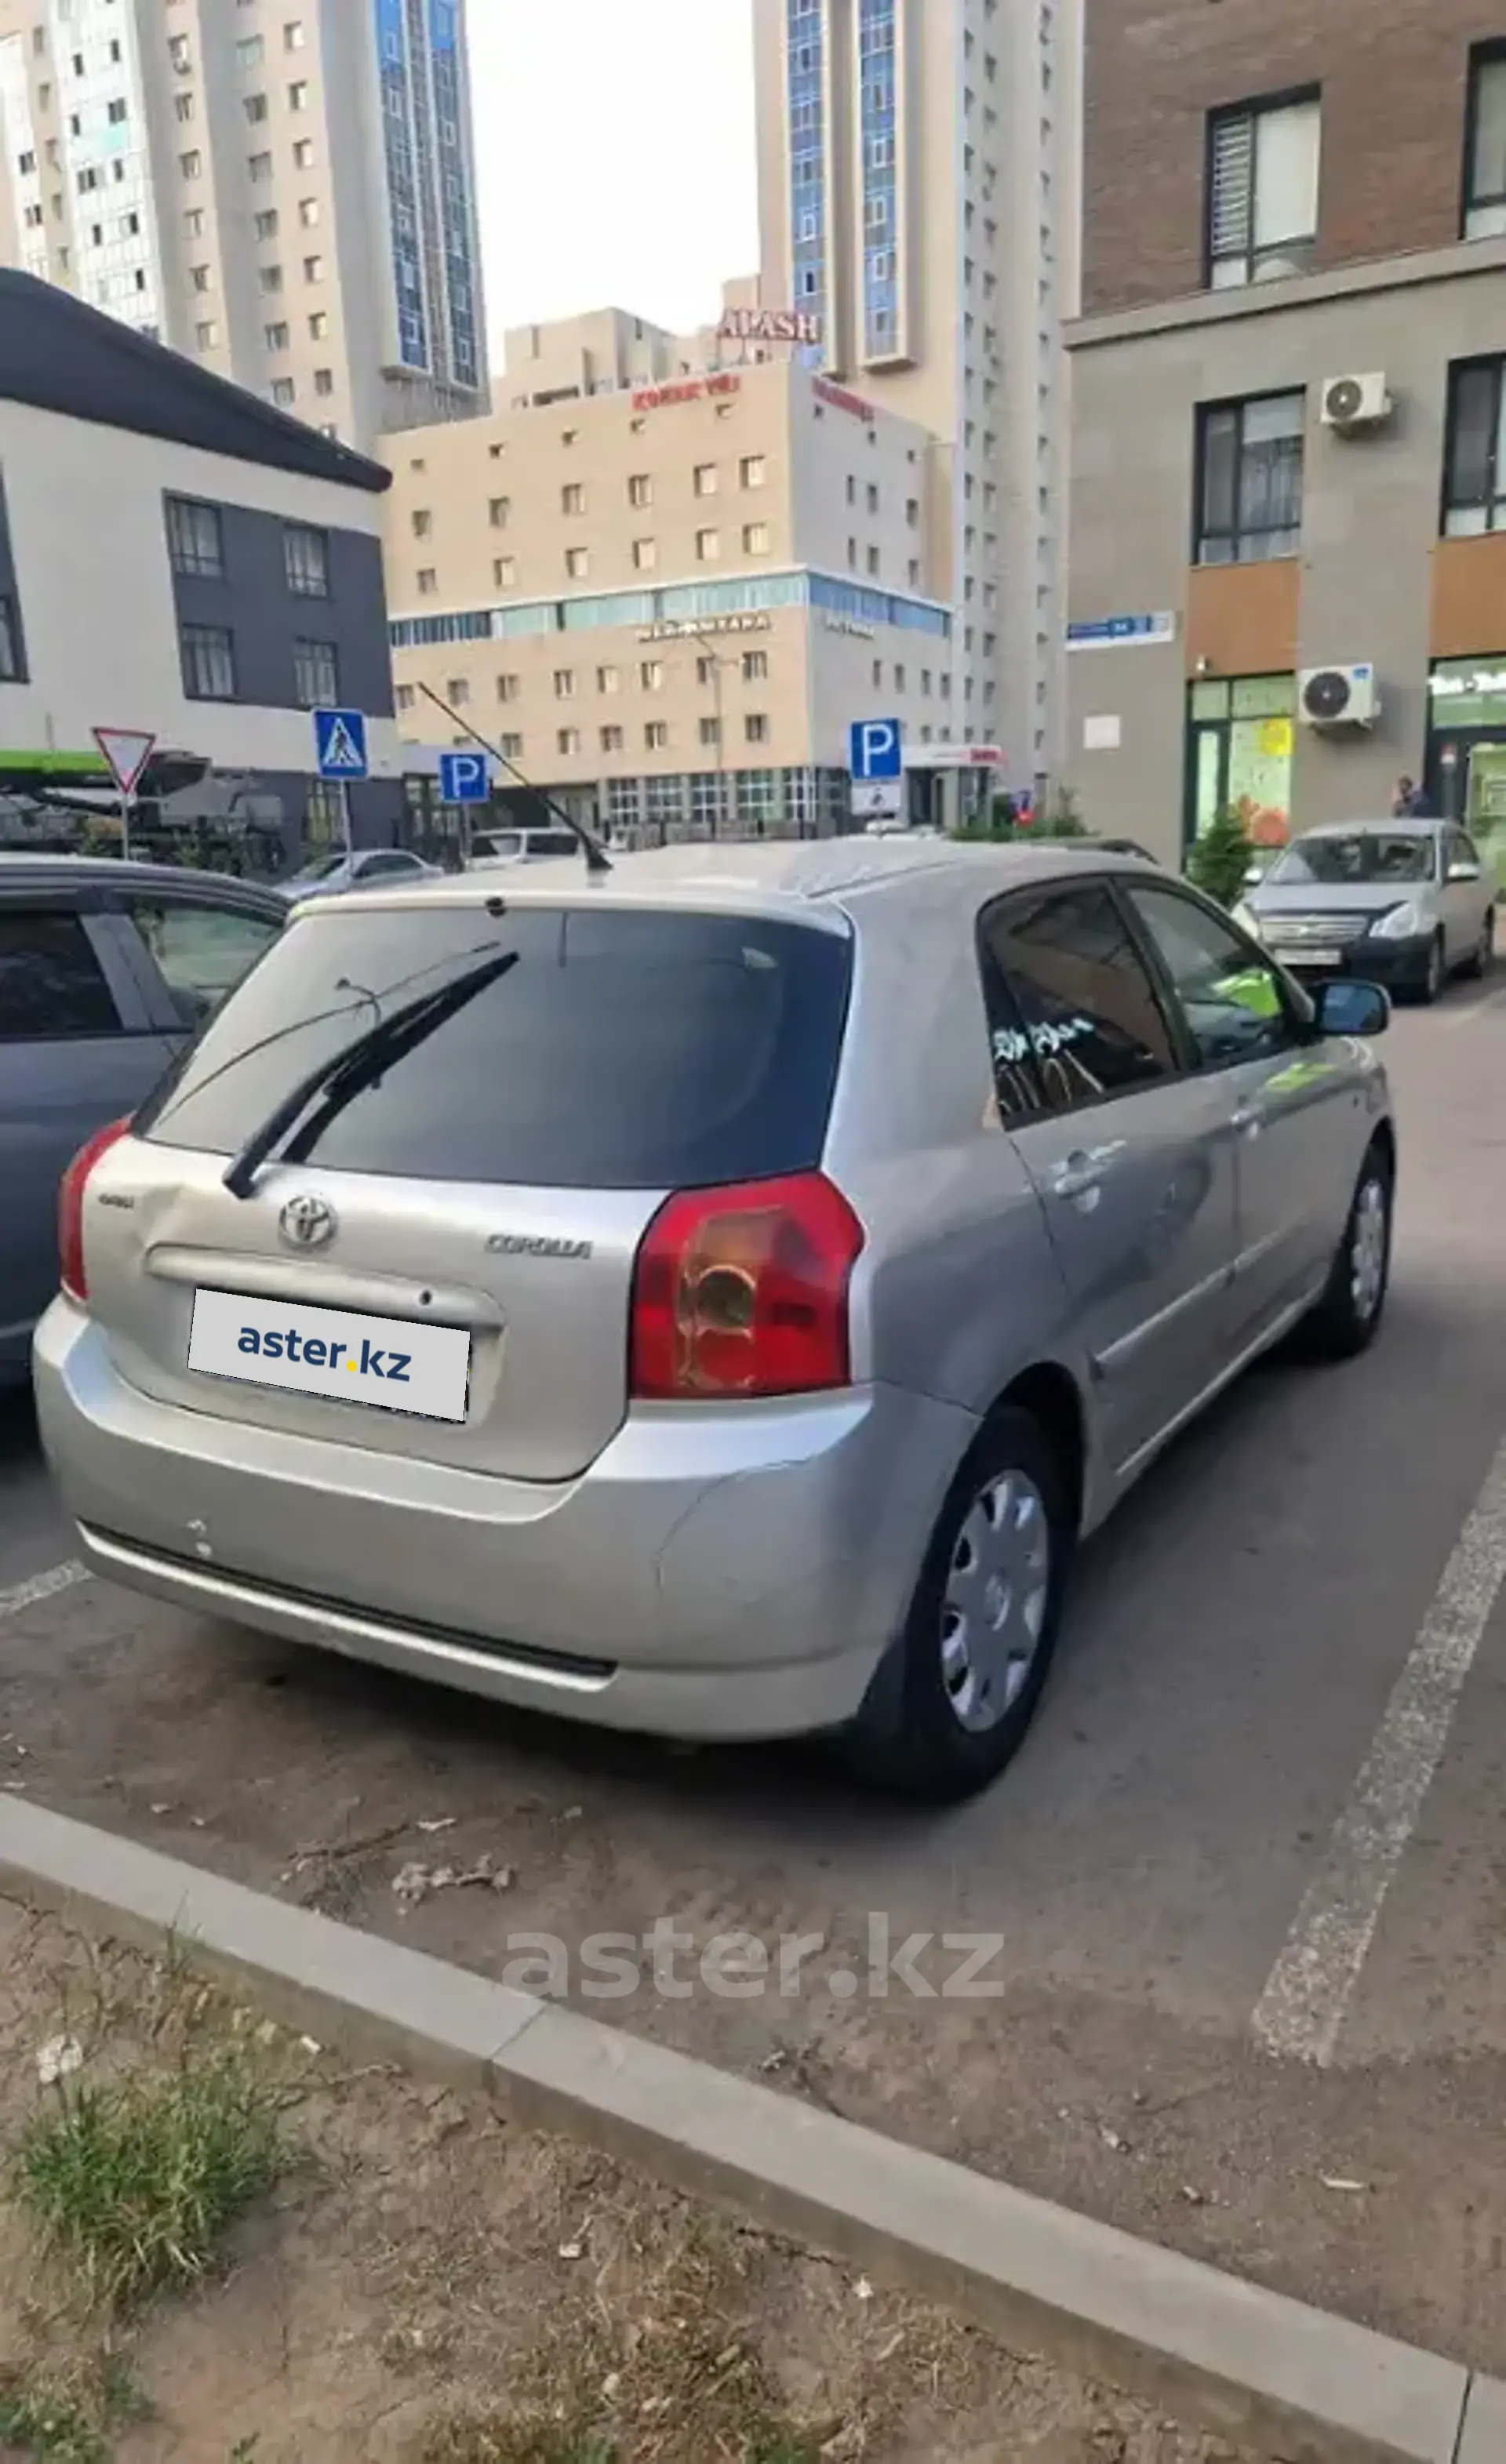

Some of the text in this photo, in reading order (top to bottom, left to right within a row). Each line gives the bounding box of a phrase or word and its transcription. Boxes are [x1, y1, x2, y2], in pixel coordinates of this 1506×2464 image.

[863, 723, 893, 777] P
[452, 758, 479, 798] P
[484, 1234, 594, 1260] COROLLA
